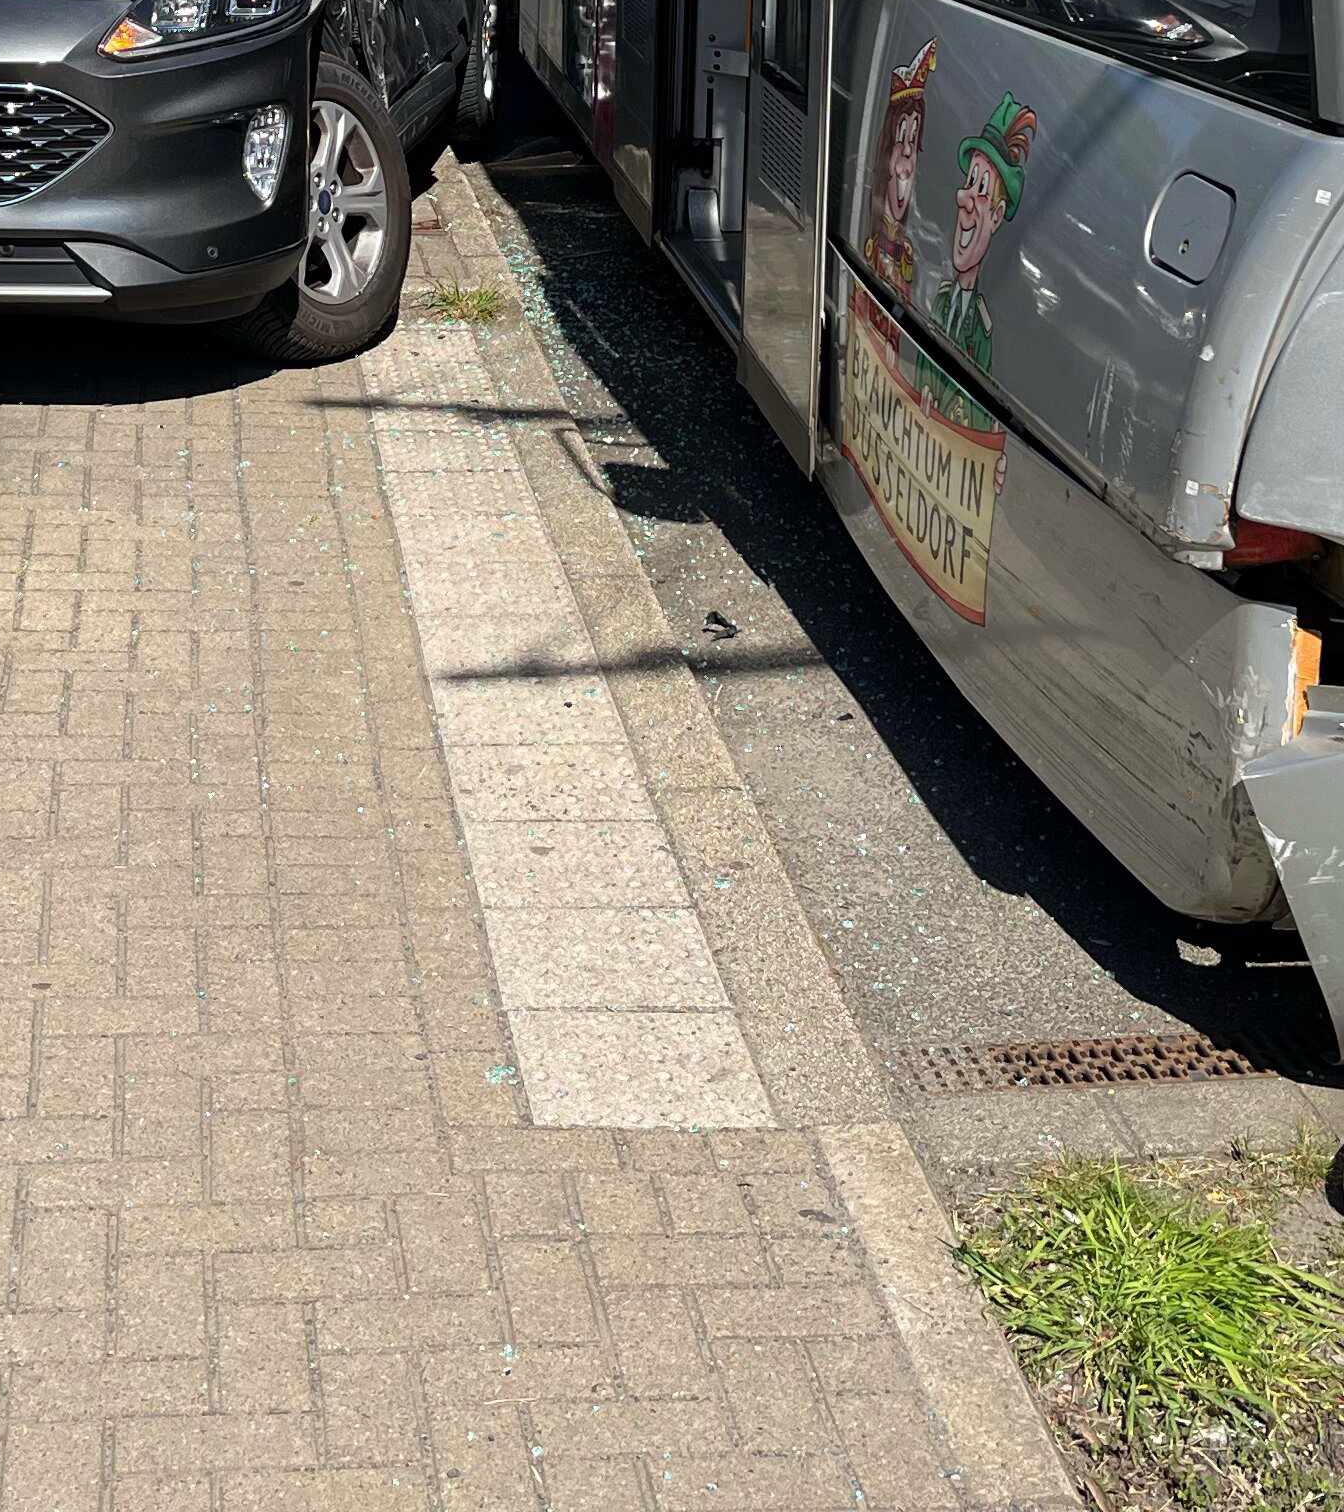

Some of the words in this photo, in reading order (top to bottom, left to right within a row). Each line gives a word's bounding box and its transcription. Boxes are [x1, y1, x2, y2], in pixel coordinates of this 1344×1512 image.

[851, 392, 974, 586] DÜSSELDORF
[852, 330, 953, 499] BRAUCHTUM
[959, 456, 985, 518] IN
